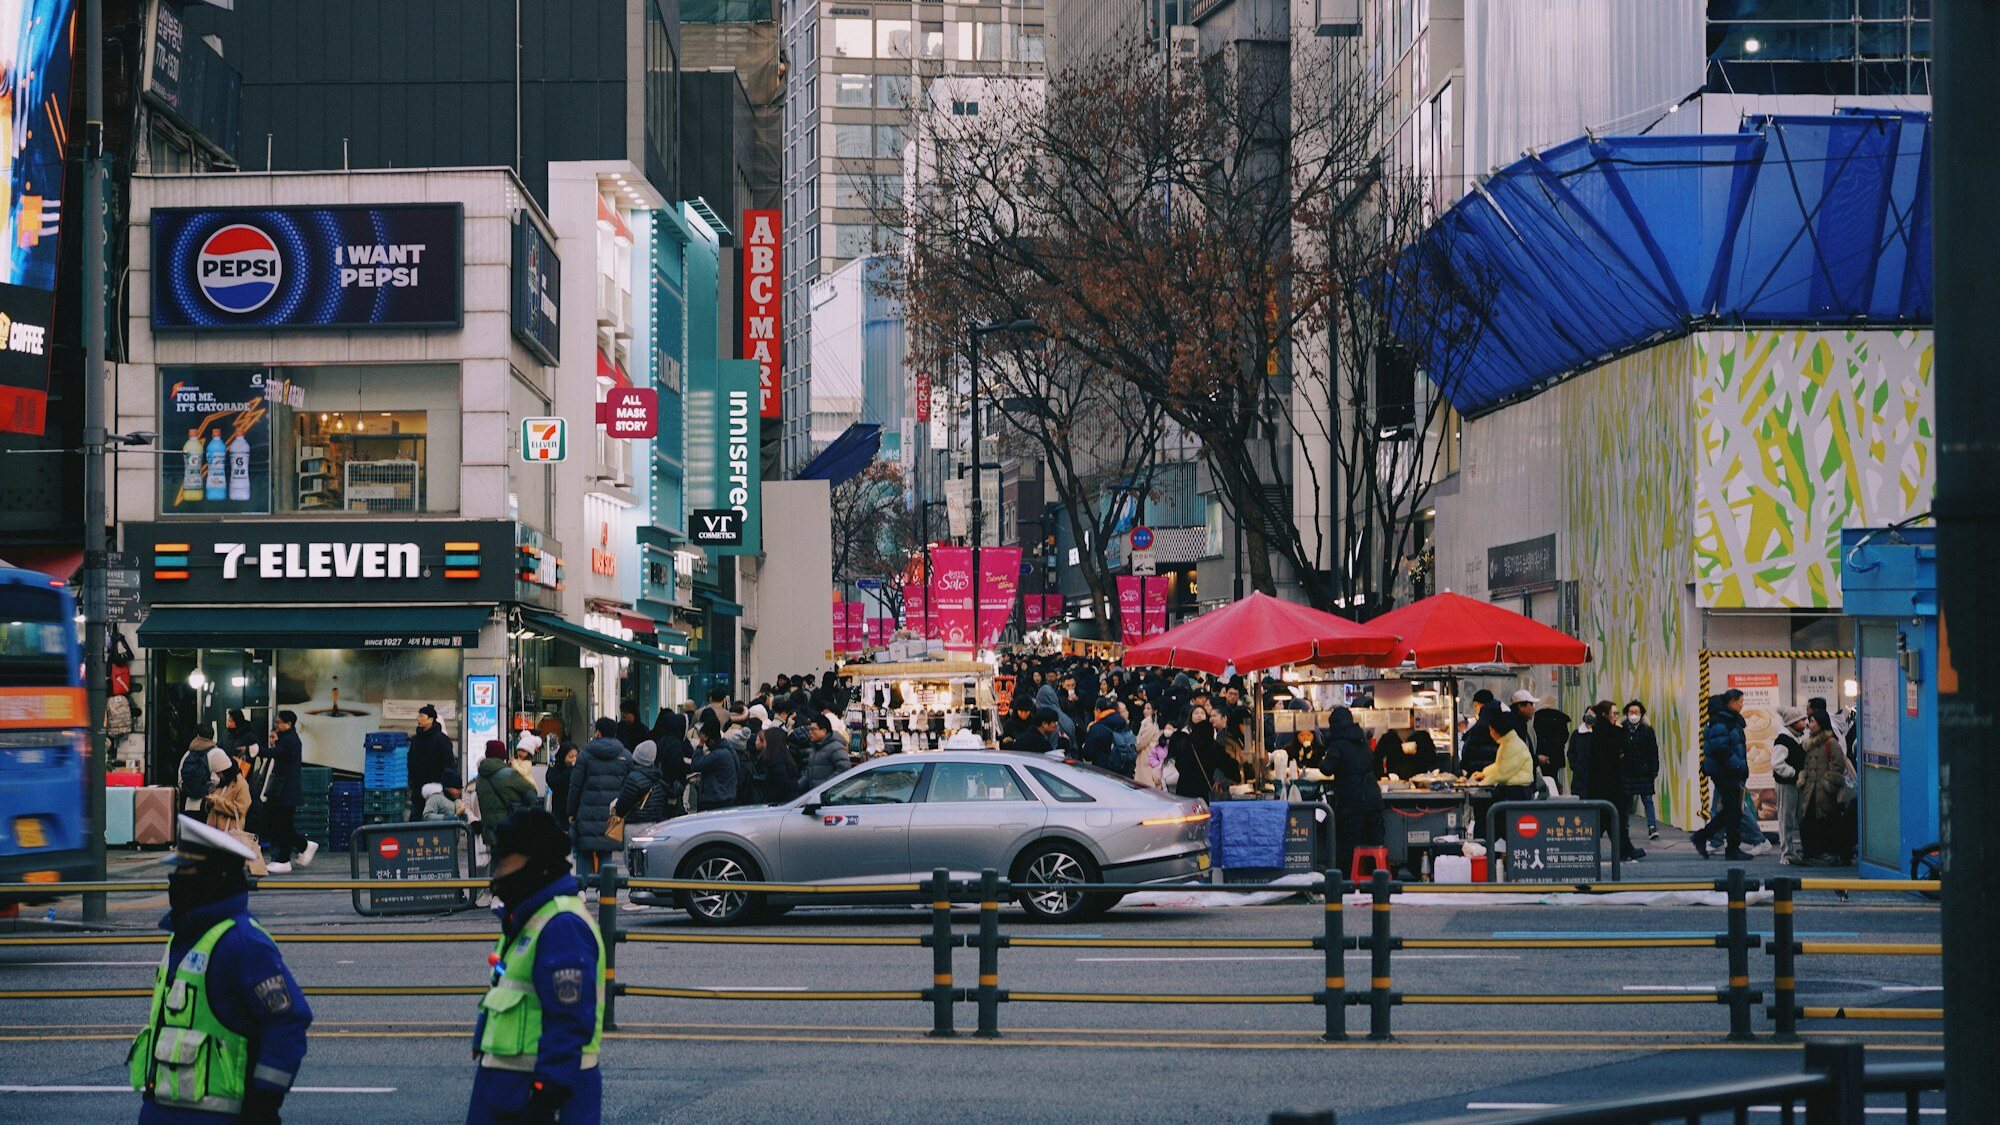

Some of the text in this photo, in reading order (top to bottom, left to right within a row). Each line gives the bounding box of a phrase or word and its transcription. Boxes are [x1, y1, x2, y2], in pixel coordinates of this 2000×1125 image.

[335, 244, 426, 265] I WANT
[203, 259, 276, 277] PEPSI
[340, 267, 418, 288] PEPSI
[10, 322, 45, 355] COFFEE
[176, 392, 216, 403] FOR ME,
[622, 395, 642, 406] ALL
[176, 402, 251, 413] IT'S GATORADE
[616, 407, 647, 419] MASK
[615, 421, 648, 432] STORY
[531, 441, 557, 449] ELEVEN
[703, 515, 733, 532] VT
[698, 531, 737, 540] COSMETICS
[213, 543, 421, 579] 7-ELEVEN
[937, 573, 969, 590] Sale
[383, 638, 402, 646] 1927
[1560, 854, 1594, 862] 10:00~23:00
[1513, 859, 1529, 870] 서울
